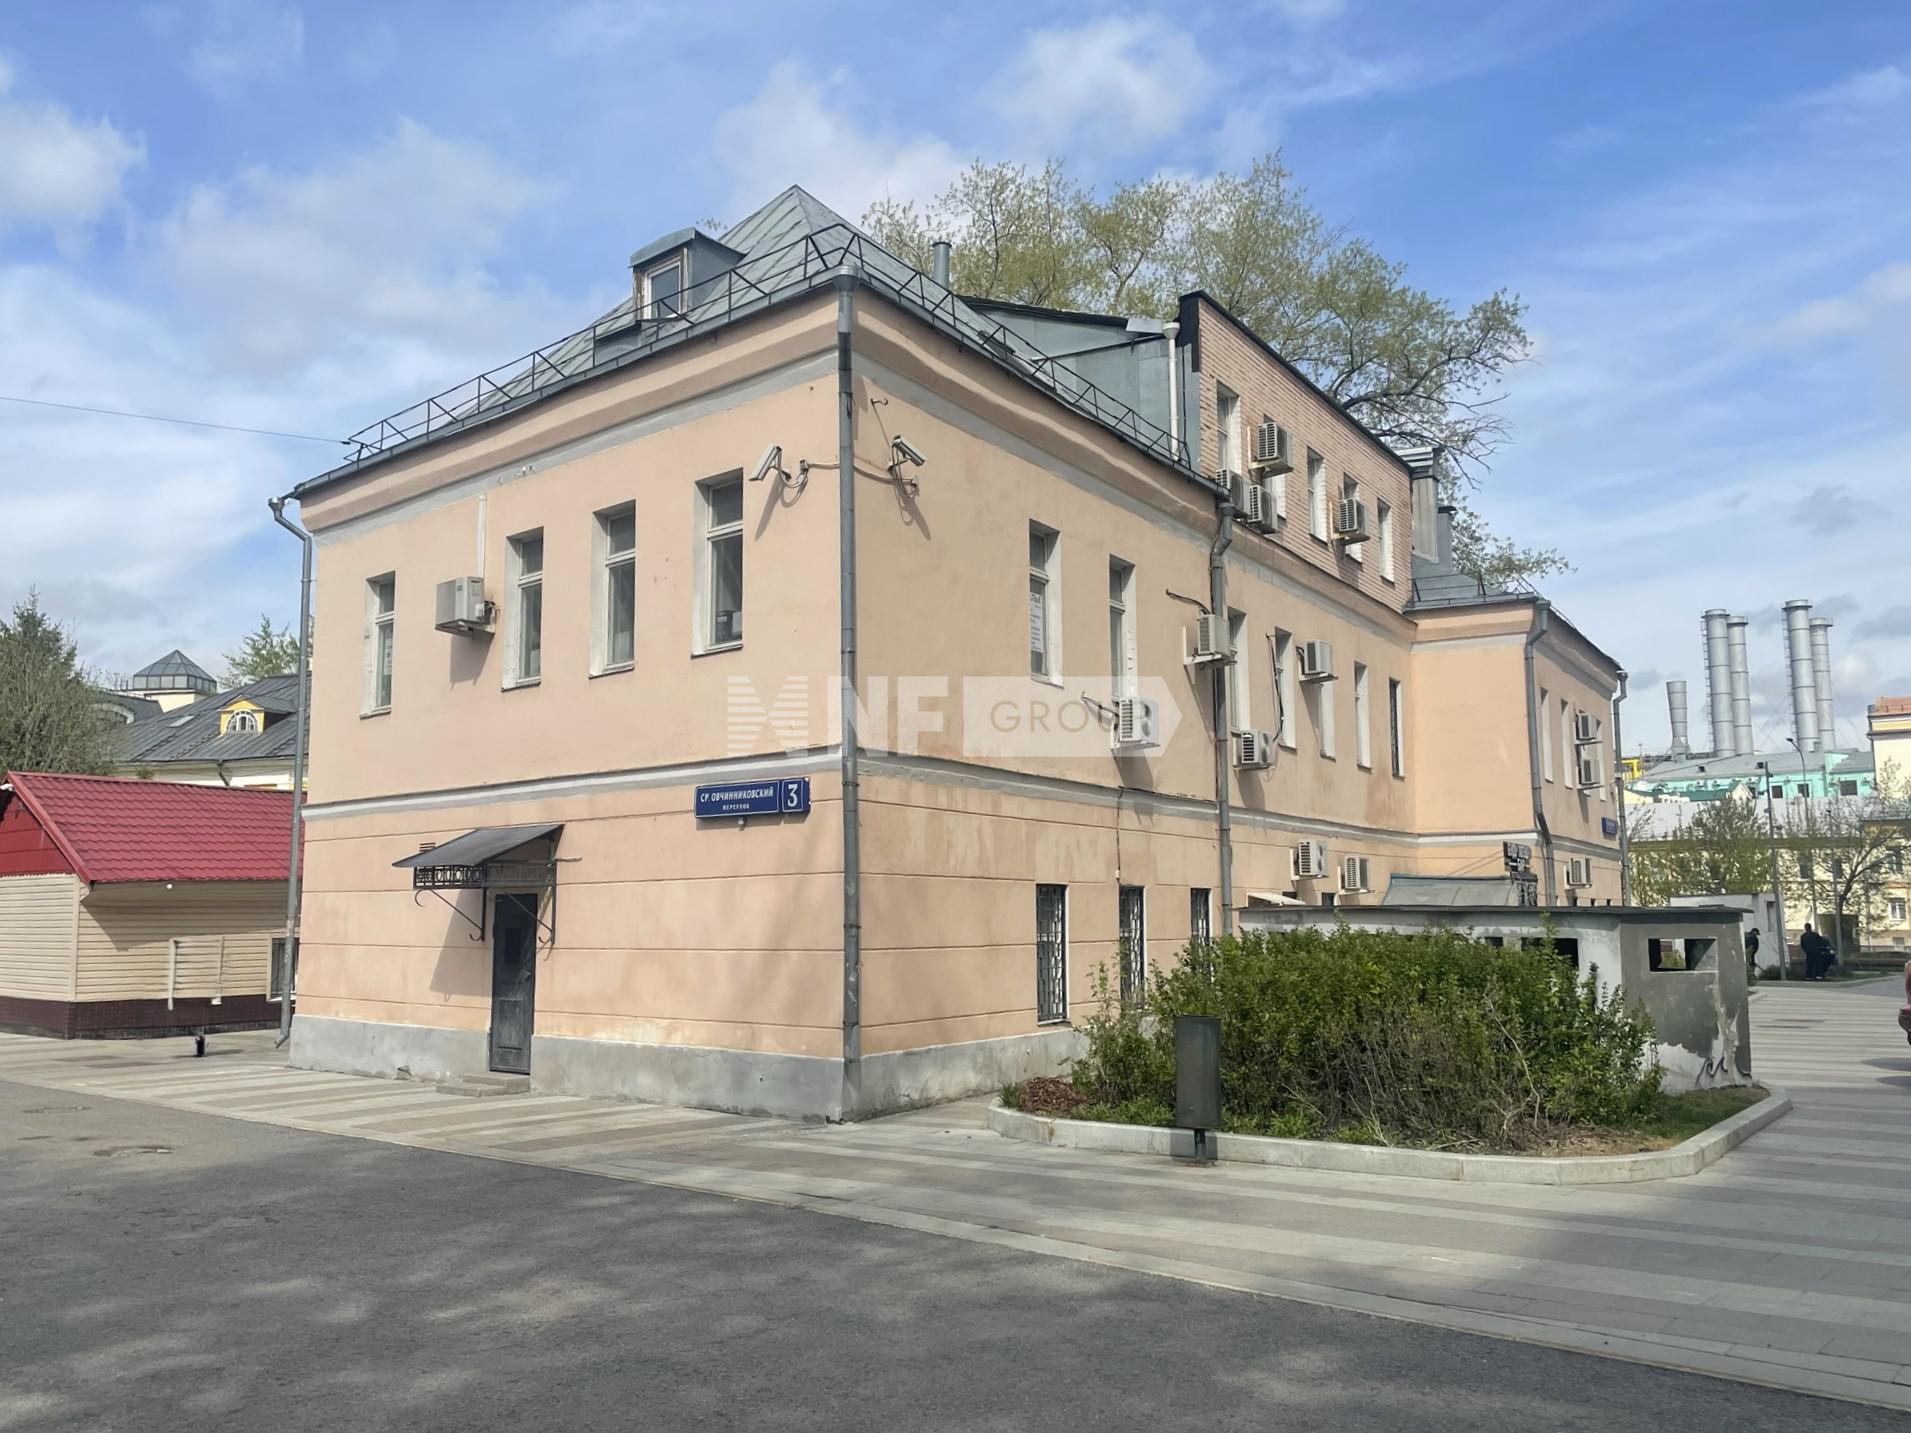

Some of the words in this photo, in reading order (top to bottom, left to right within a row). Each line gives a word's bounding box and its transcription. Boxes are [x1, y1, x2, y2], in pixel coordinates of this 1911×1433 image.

[700, 793, 711, 802] СР.
[711, 787, 774, 802] ОВЧИННИКОВСКИЙ
[787, 784, 798, 807] 3
